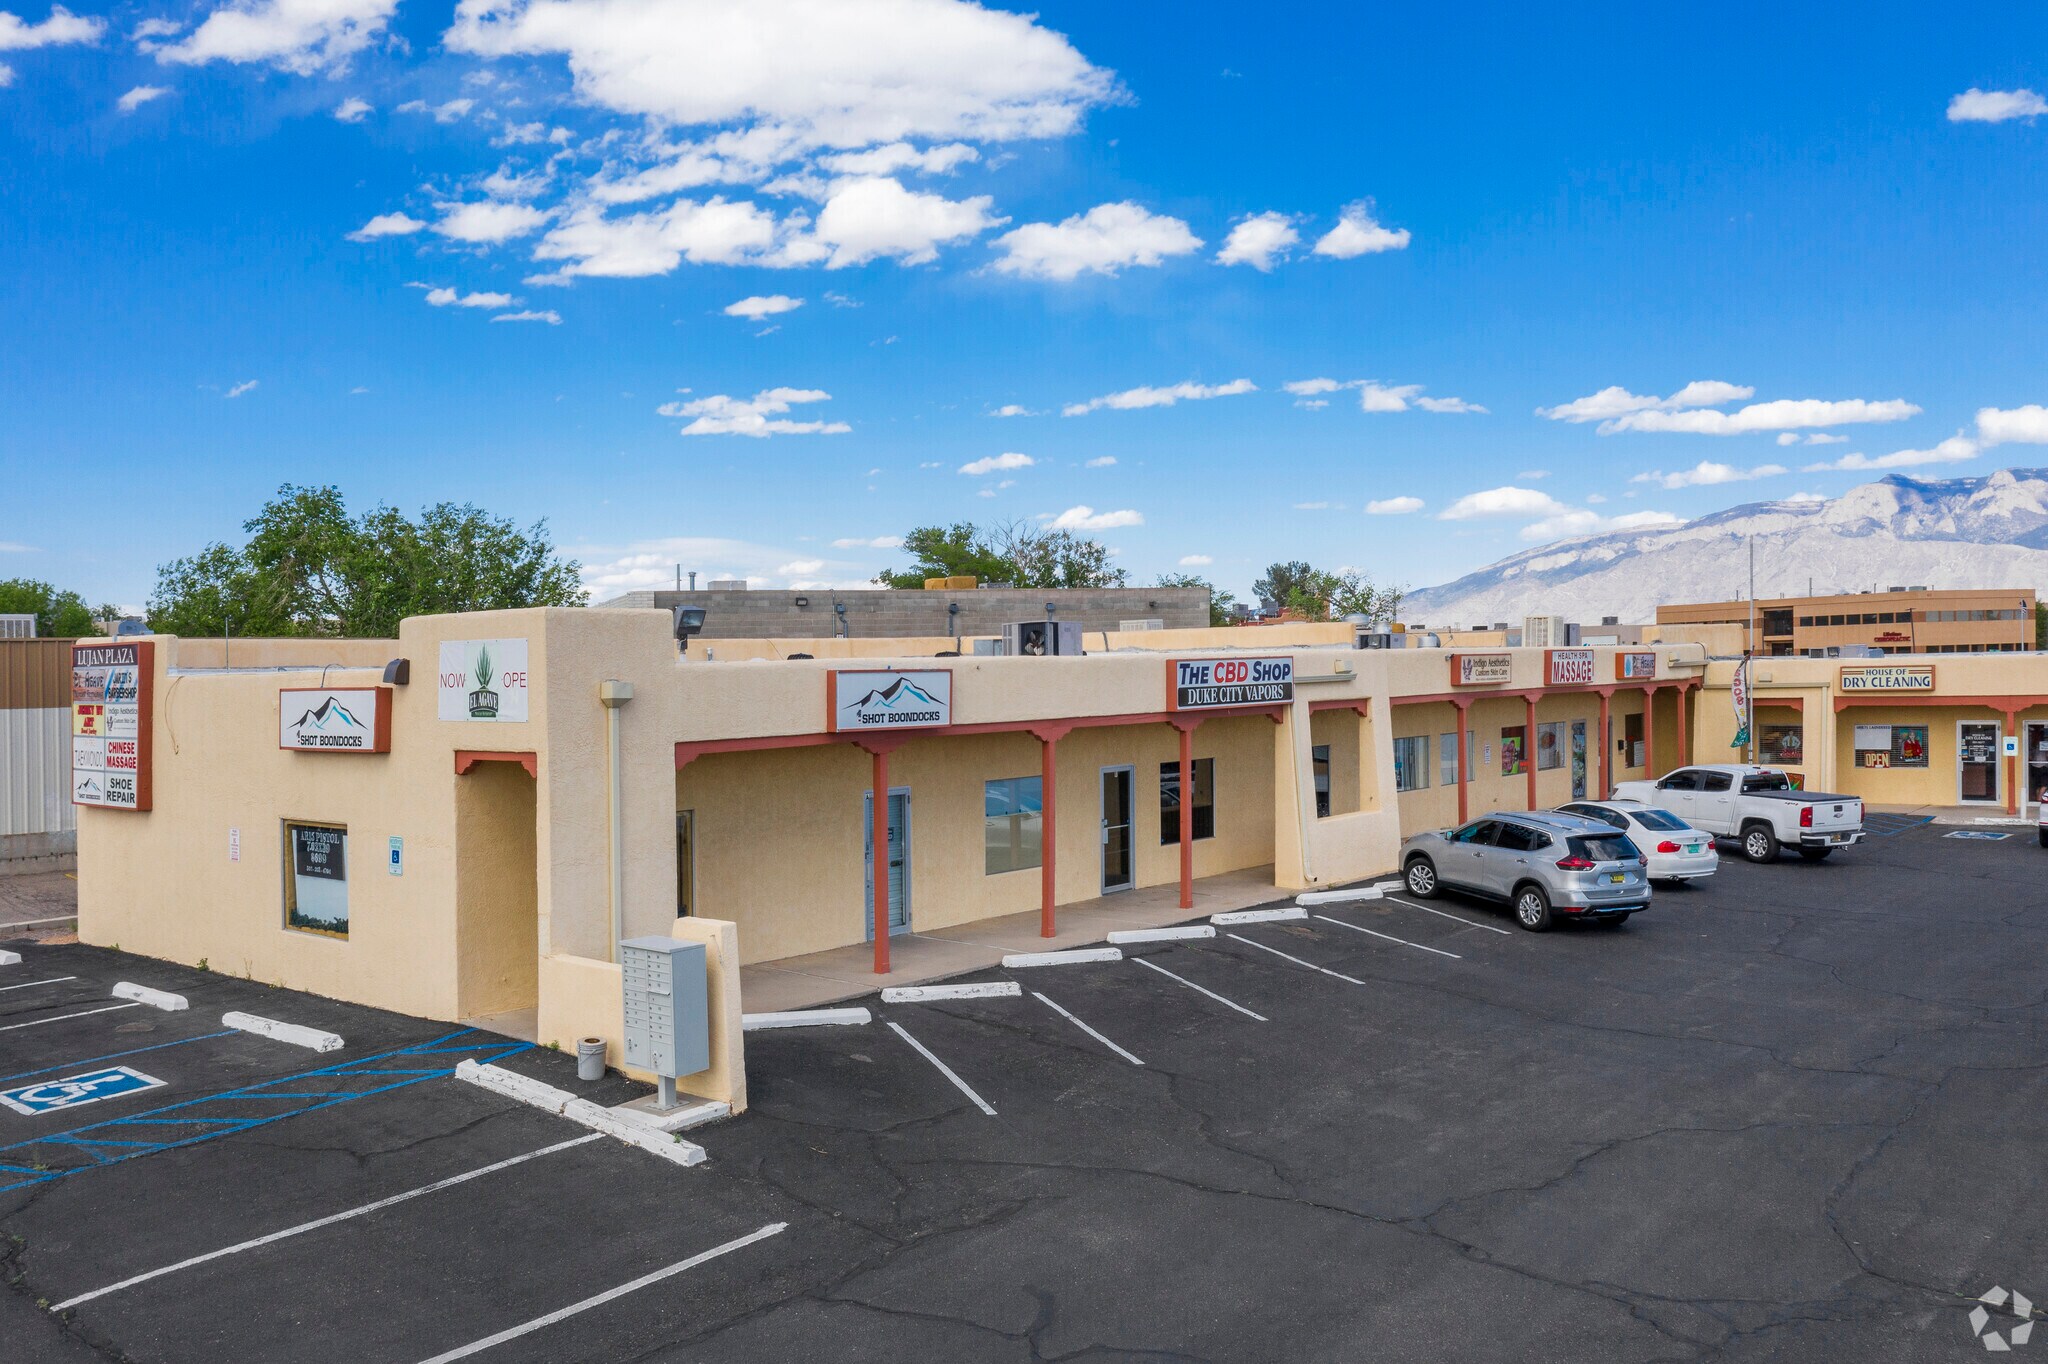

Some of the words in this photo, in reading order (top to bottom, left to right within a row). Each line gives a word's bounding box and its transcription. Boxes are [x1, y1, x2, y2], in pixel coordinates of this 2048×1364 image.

[77, 649, 103, 666] LUJAN
[105, 648, 134, 663] PLAZA
[1558, 652, 1577, 660] HEALTH
[1472, 659, 1487, 669] Indigo
[1488, 658, 1510, 667] Aesthetics
[1180, 663, 1209, 685] THE
[1214, 661, 1248, 683] CBD
[1252, 661, 1291, 682] SHOP
[1553, 661, 1592, 682] MASSAGE
[440, 673, 466, 688] NOW
[503, 672, 527, 688] OPE
[1843, 677, 1868, 688] DRY
[1871, 676, 1930, 688] CLEANING
[108, 687, 138, 699] BARBERSHOP
[1188, 688, 1217, 704] DUKE
[1220, 686, 1244, 703] CITY
[1246, 684, 1284, 700] VAPORS
[469, 695, 477, 709] EL
[478, 692, 498, 709] AGAVE
[862, 713, 886, 724] SHOT
[888, 711, 941, 723] BOONDOCKS
[300, 734, 318, 746] SHOT
[319, 735, 362, 747] BOONDOCKS
[108, 742, 135, 754] CHINESE
[106, 756, 136, 769] MASSAGE
[1865, 753, 1889, 767] OPEN
[110, 778, 132, 790] SHOE
[106, 791, 135, 803] REPAIR
[315, 832, 339, 844] PISTOL
